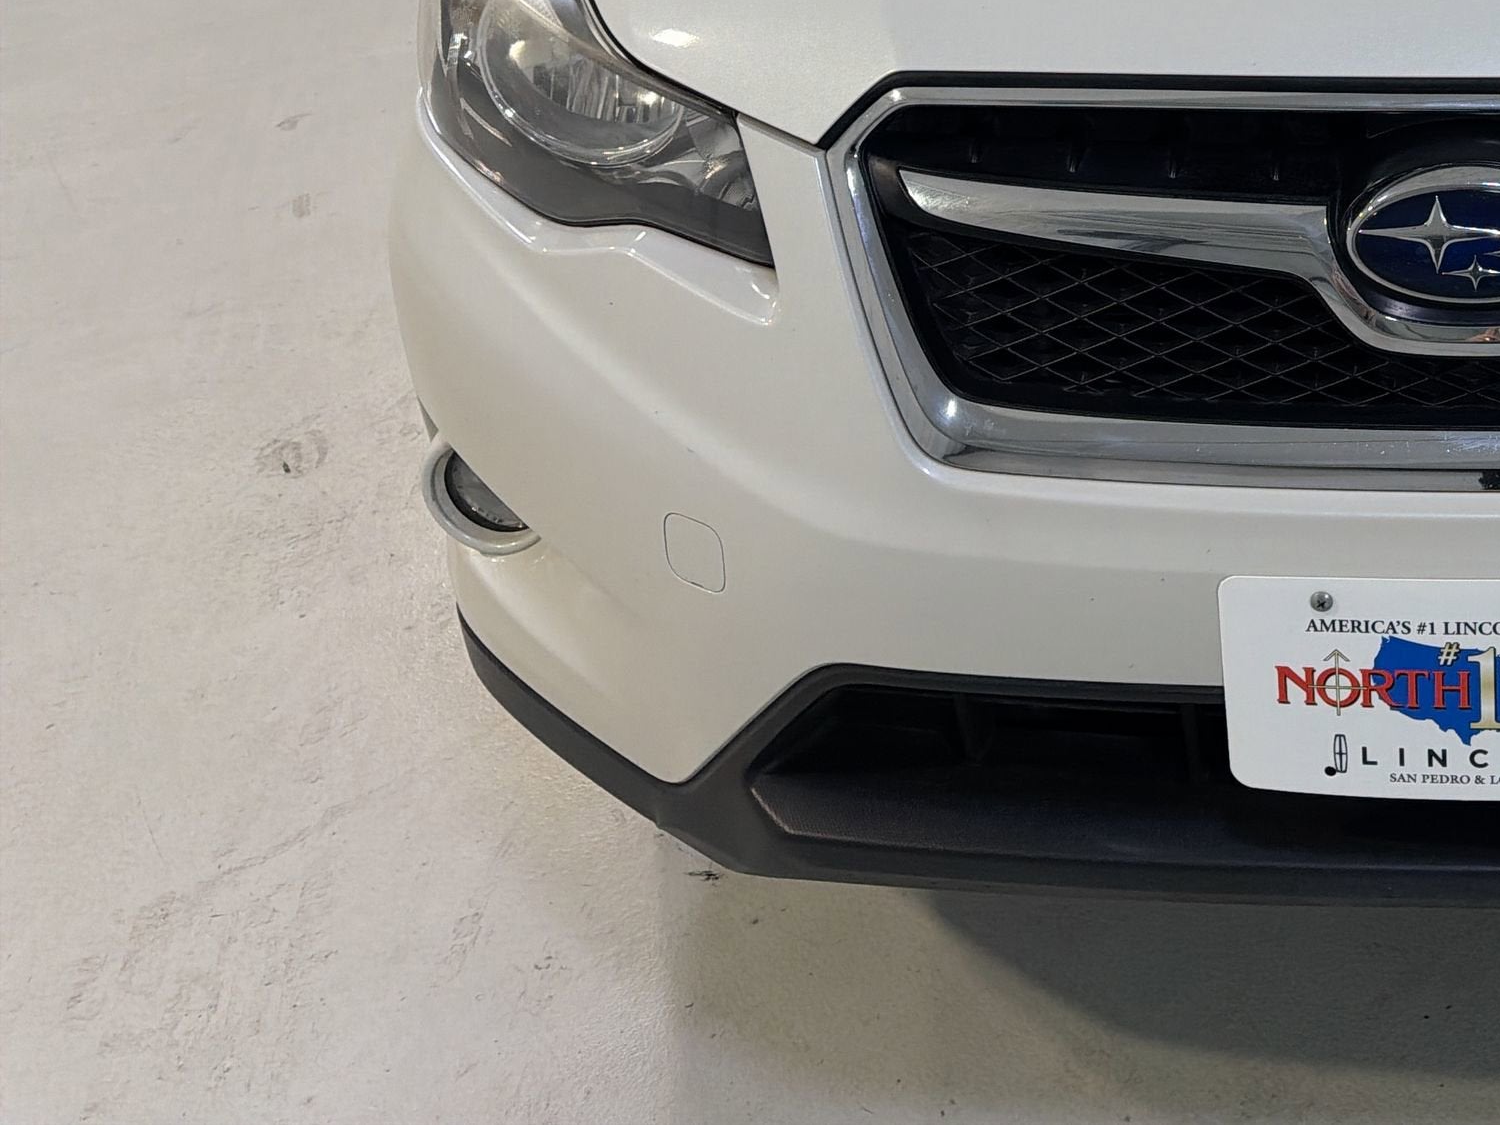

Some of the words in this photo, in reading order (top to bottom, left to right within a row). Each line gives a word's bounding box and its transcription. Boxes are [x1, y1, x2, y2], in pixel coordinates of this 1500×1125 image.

[1305, 618, 1411, 635] AMERICA'S
[1417, 621, 1437, 635] #1
[1274, 665, 1473, 711] NORTH
[1389, 772, 1418, 784] SAN
[1422, 773, 1471, 785] PEDRO
[1474, 774, 1486, 785] &
